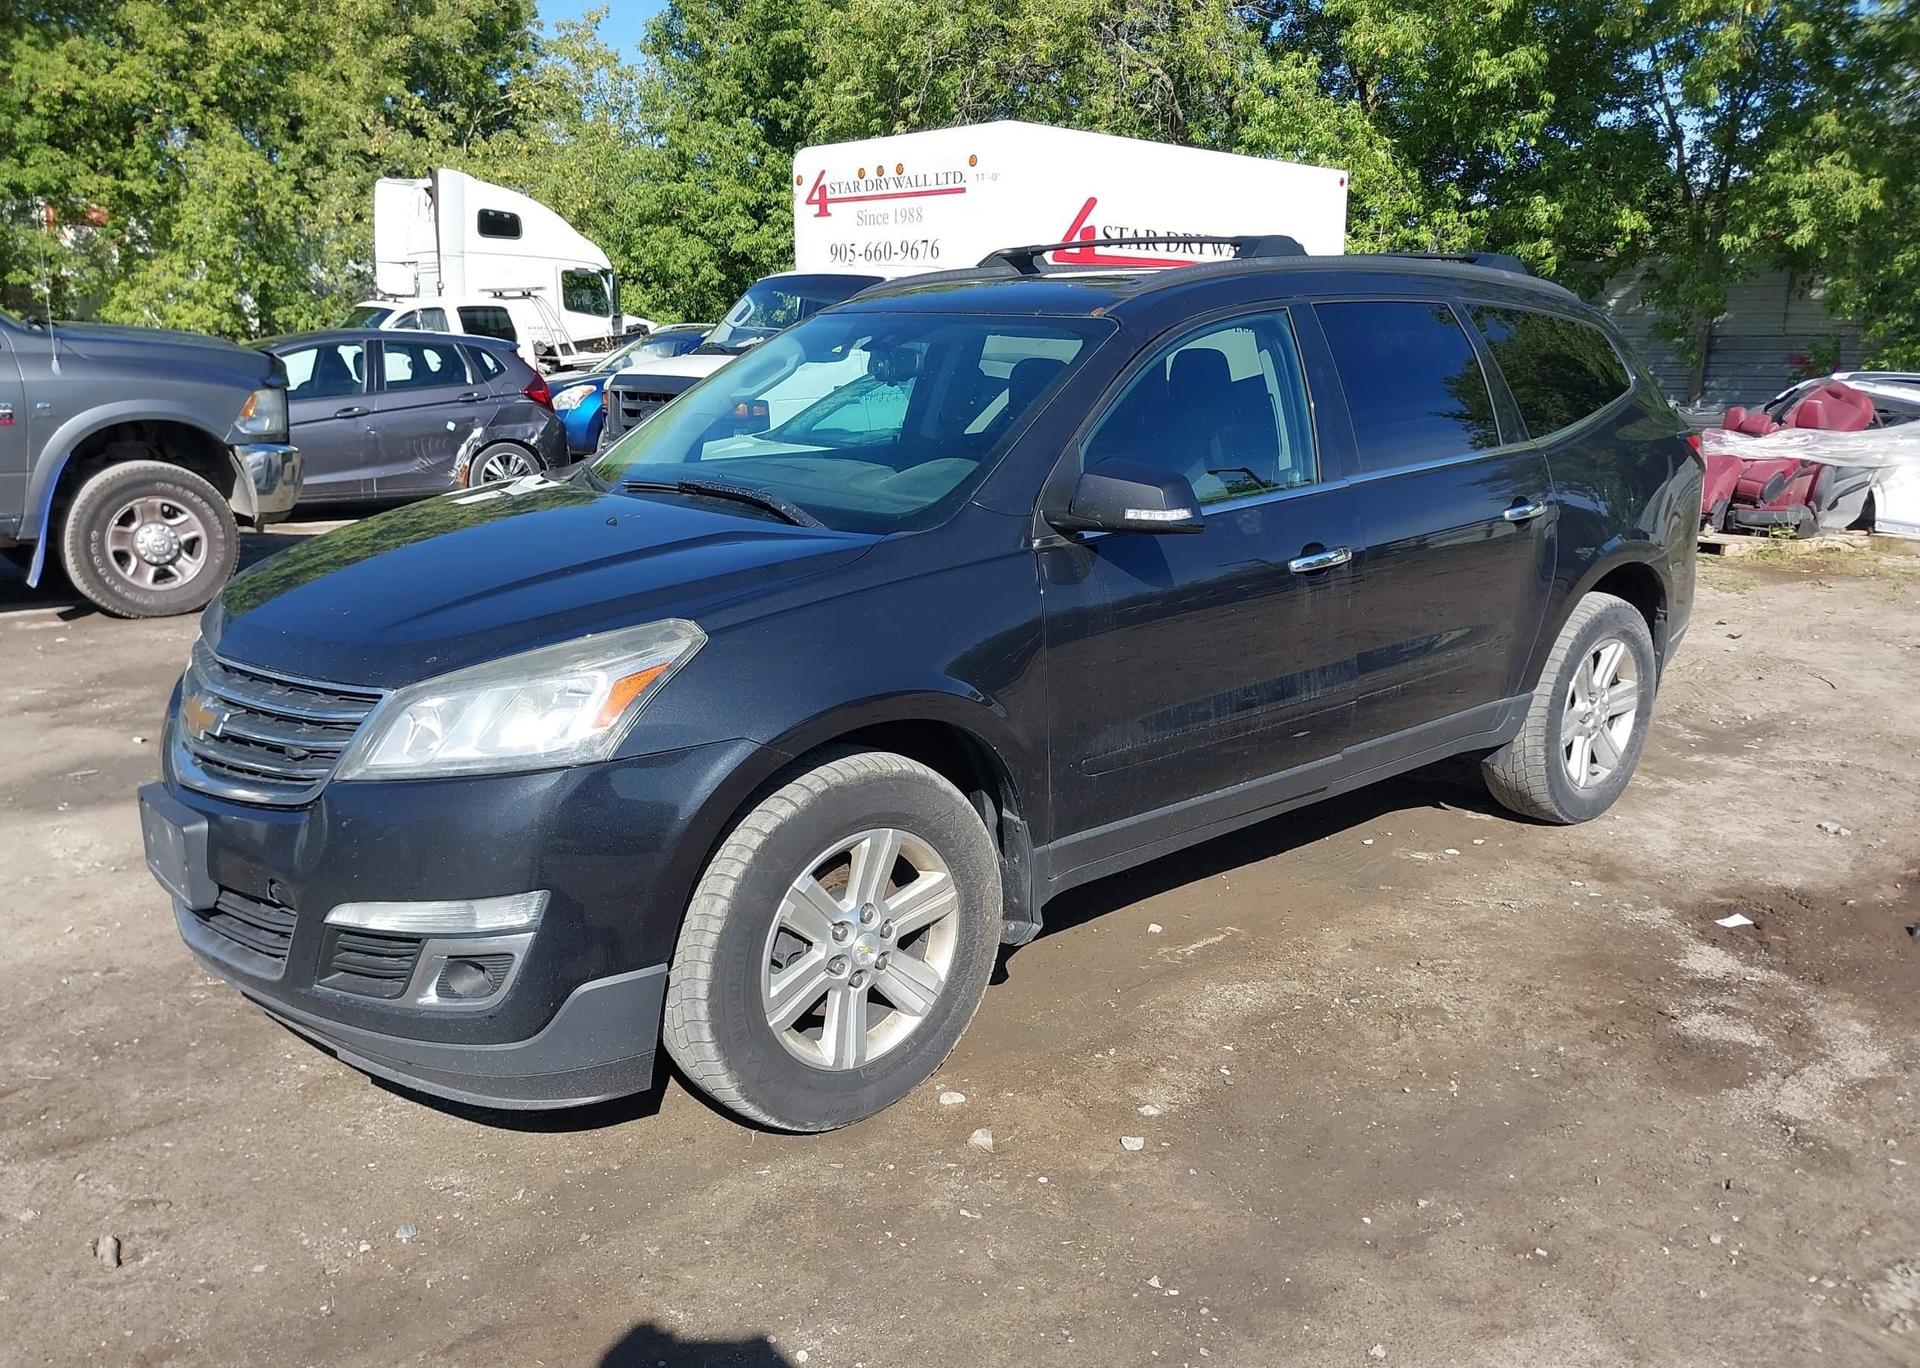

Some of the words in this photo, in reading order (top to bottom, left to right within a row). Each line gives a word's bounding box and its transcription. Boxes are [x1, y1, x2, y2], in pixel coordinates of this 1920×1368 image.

[805, 169, 832, 218] 4
[829, 180, 862, 195] STAR
[865, 173, 932, 192] DRYWALL
[935, 170, 967, 186] LTD.
[856, 209, 889, 227] Since
[894, 206, 923, 225] 1988
[830, 239, 940, 263] 905-660-9676
[1102, 225, 1159, 252] STAR
